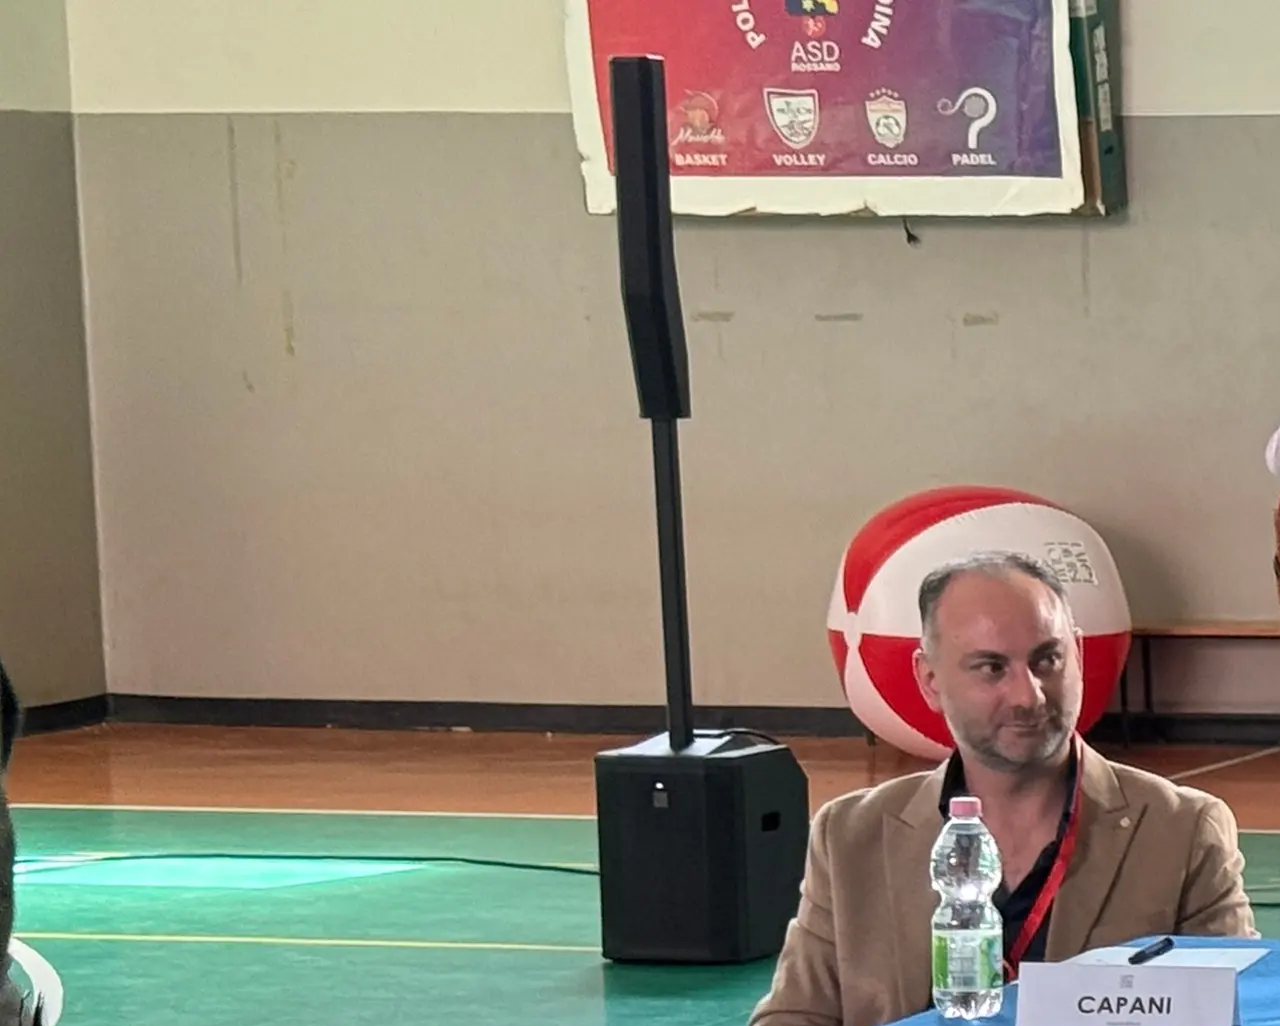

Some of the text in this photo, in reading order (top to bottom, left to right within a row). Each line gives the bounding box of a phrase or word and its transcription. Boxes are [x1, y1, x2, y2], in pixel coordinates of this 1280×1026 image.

[791, 40, 840, 61] ASD
[674, 153, 728, 166] BASKET
[772, 153, 826, 166] VOLLEY
[867, 153, 919, 166] CALCIO
[951, 153, 997, 166] PADEL
[1077, 996, 1172, 1015] CAPANI
